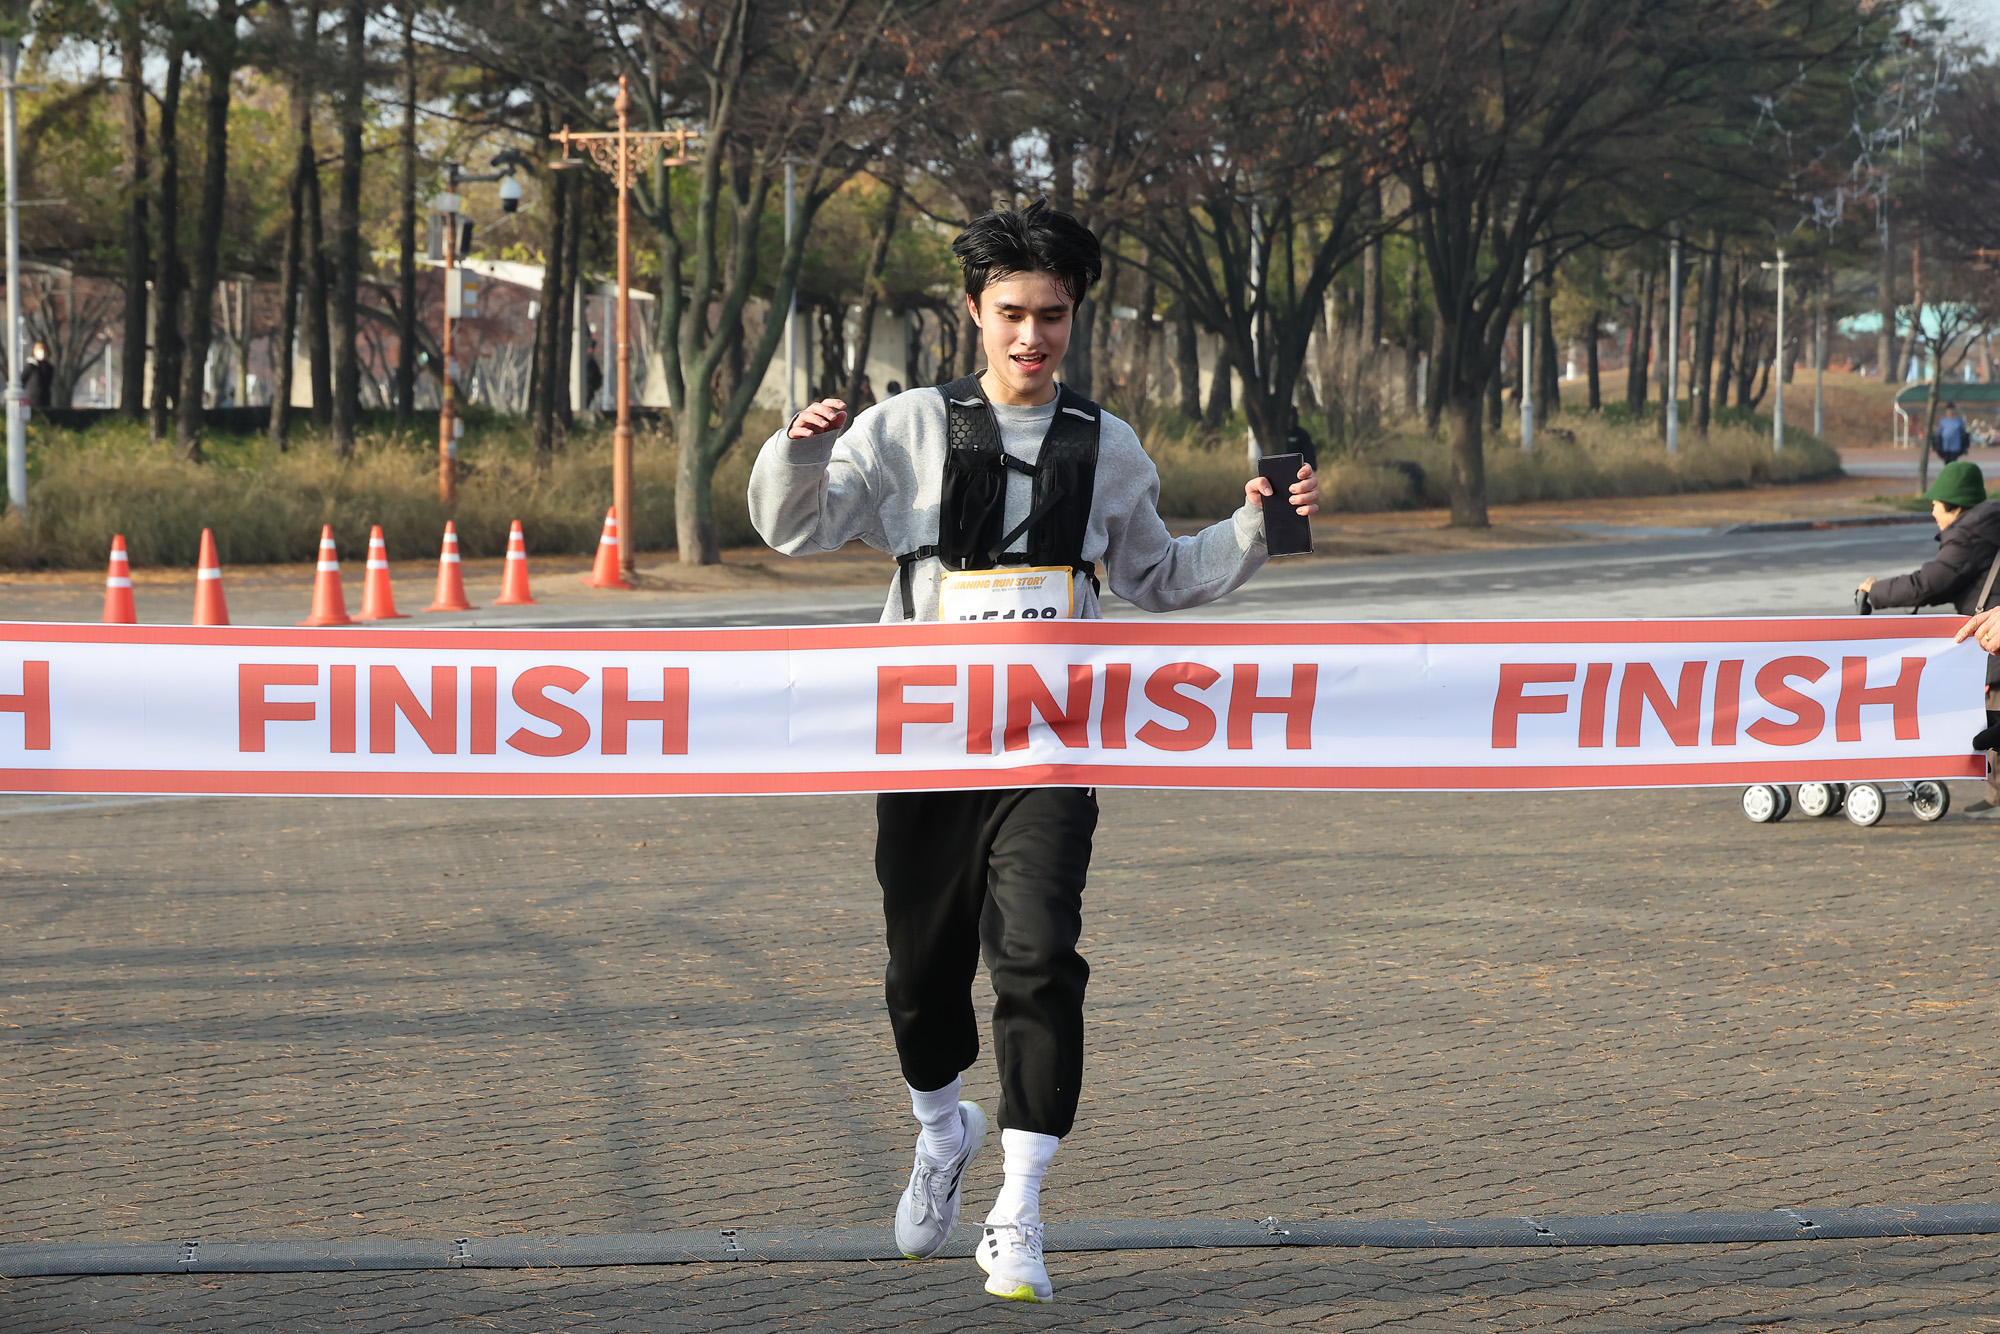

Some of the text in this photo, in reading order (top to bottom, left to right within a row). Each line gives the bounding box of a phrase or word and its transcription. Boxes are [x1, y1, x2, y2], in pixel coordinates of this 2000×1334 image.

[992, 578, 1014, 588] RUN
[1015, 576, 1047, 587] STORY
[239, 664, 690, 757] FINISH
[876, 662, 1318, 755] FINISH
[1492, 655, 1927, 748] FINISH
